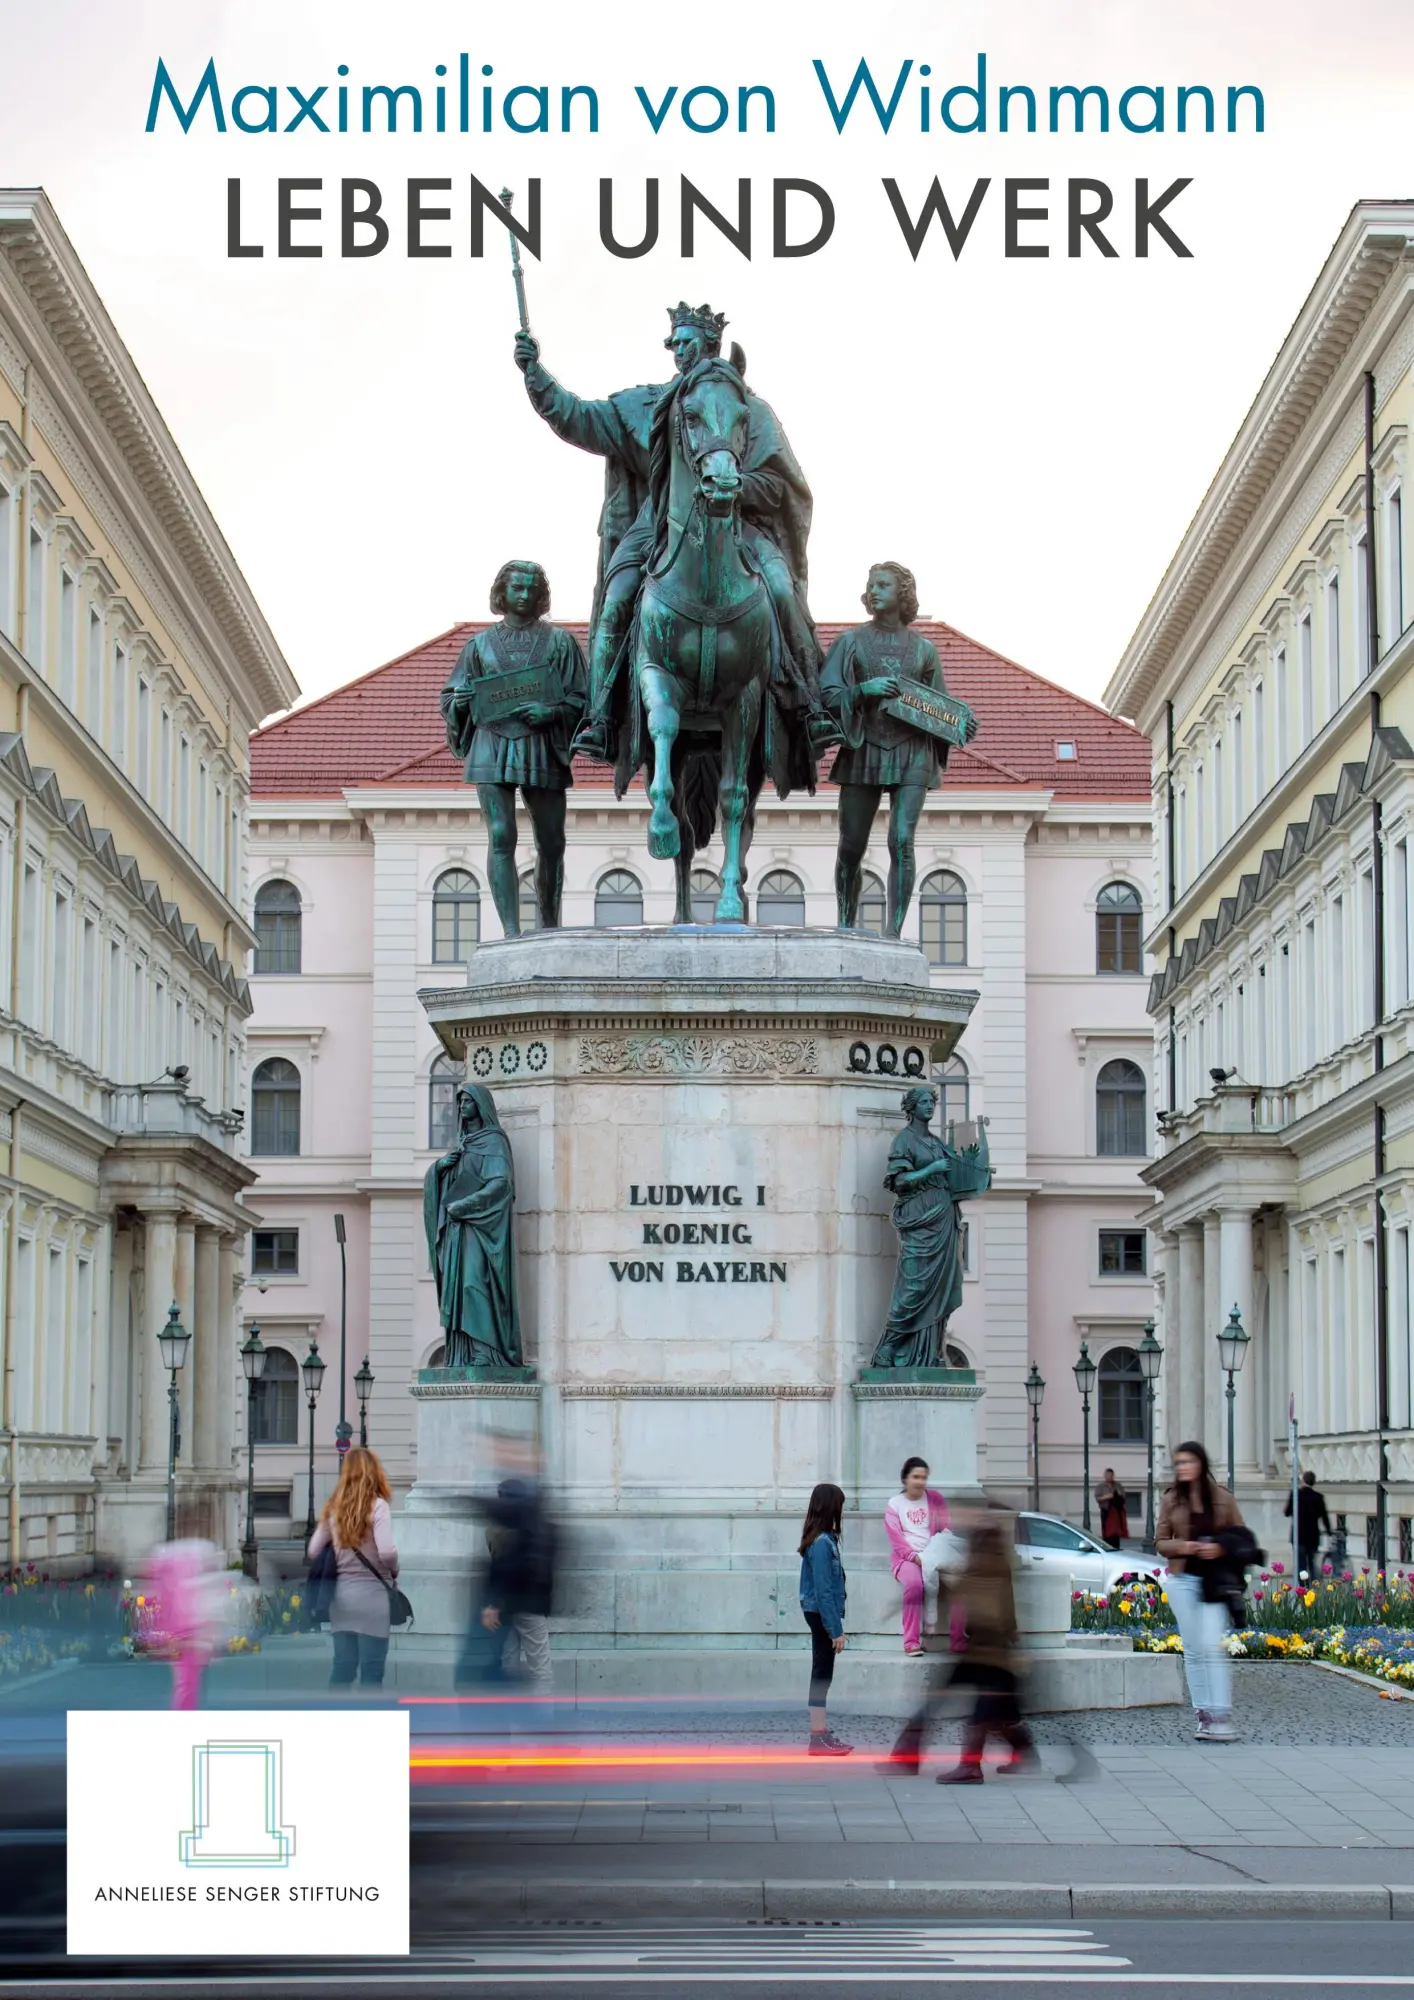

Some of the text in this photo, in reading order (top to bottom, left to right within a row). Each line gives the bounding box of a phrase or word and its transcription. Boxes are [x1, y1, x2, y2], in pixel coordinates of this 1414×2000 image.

[629, 1185, 766, 1206] LUDWIG I
[642, 1223, 752, 1245] KOENIG
[608, 1261, 788, 1283] VON BAYERN
